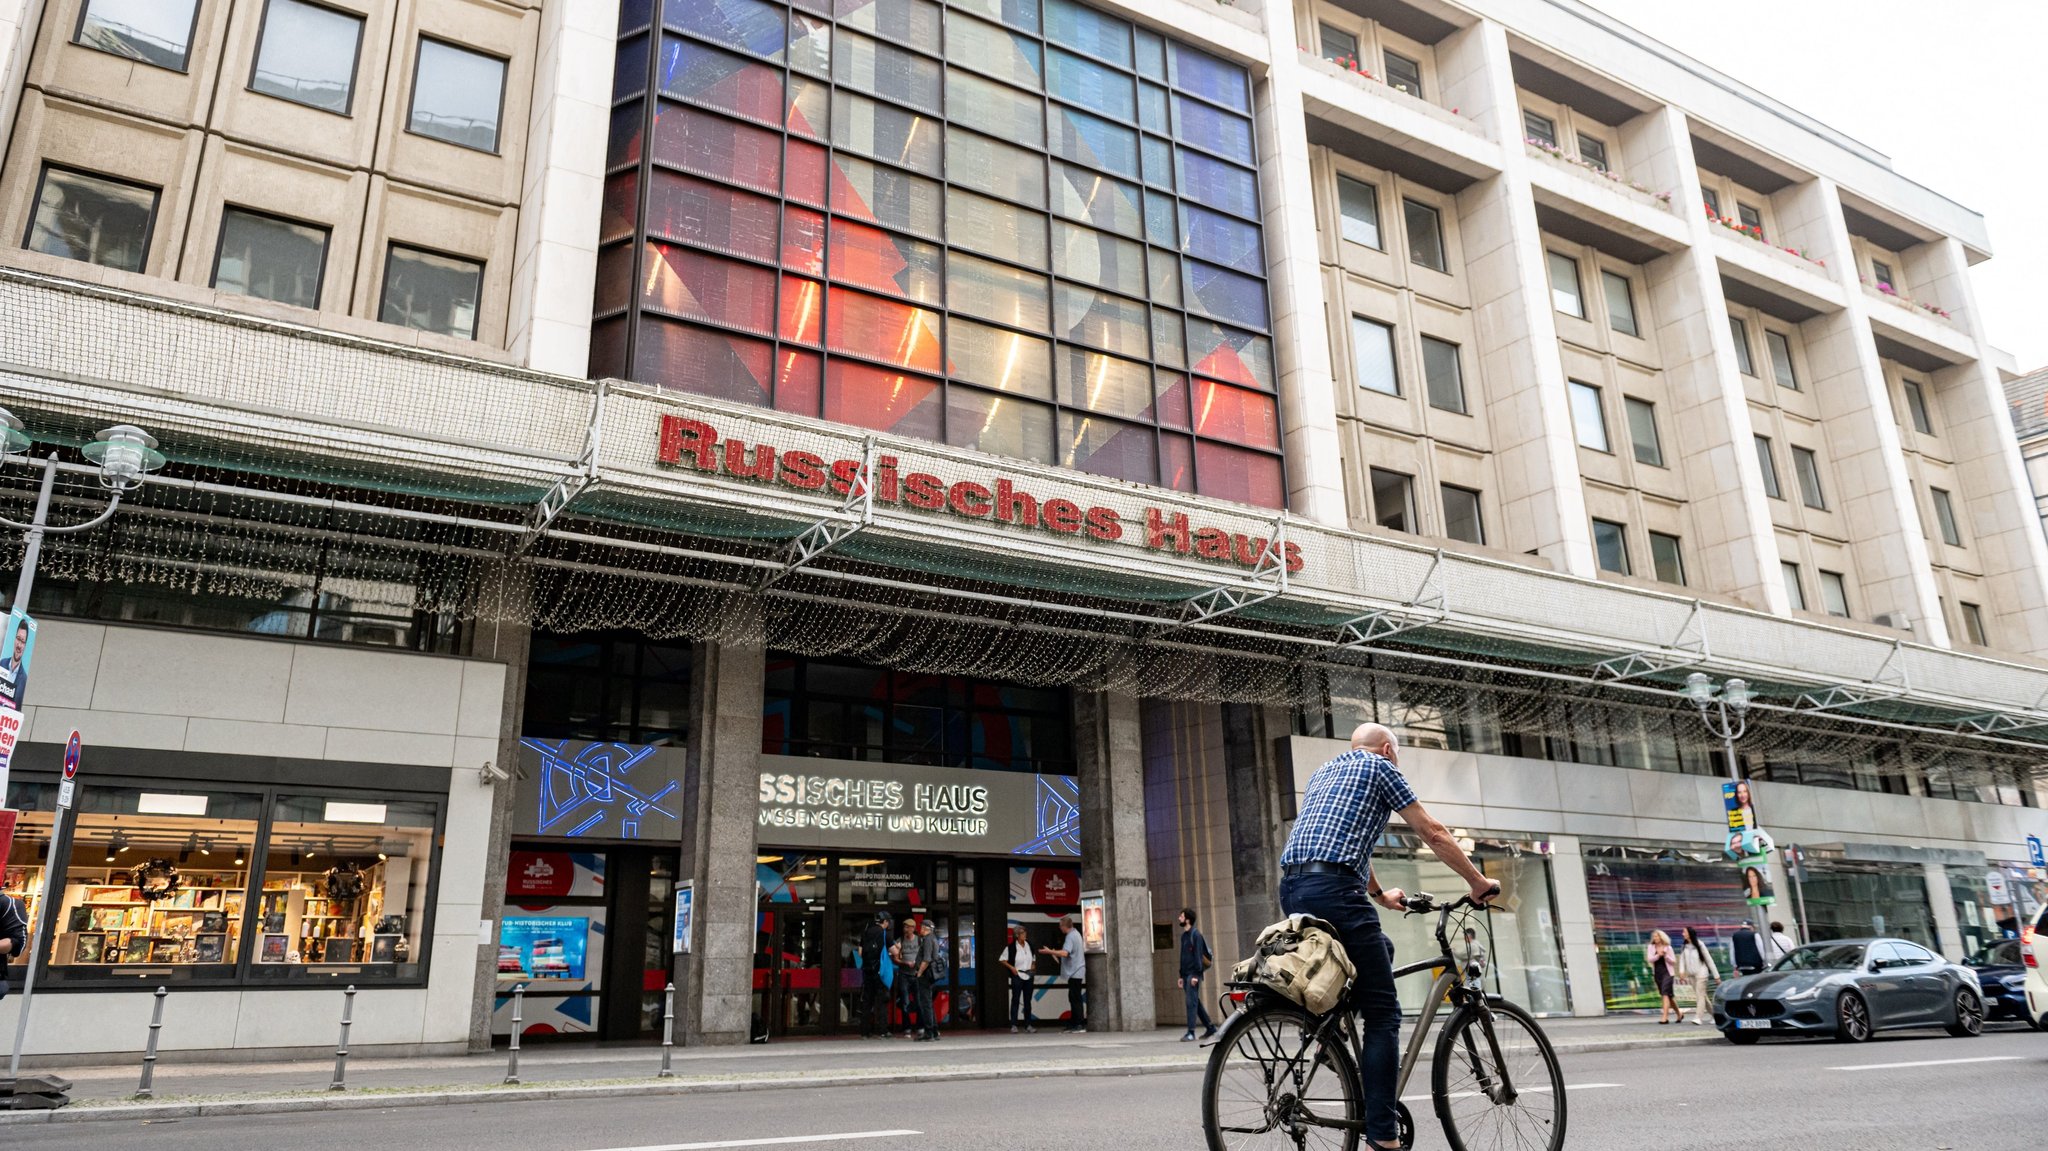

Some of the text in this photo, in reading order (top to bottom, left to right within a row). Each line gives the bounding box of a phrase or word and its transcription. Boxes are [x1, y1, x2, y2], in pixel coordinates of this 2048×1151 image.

[658, 414, 1304, 571] Russisches Haus
[0, 682, 16, 698] chaal
[760, 773, 988, 812] SSISCHES HAUS
[888, 814, 924, 832] UND
[927, 816, 988, 835] KULTUR
[2028, 841, 2040, 862] P
